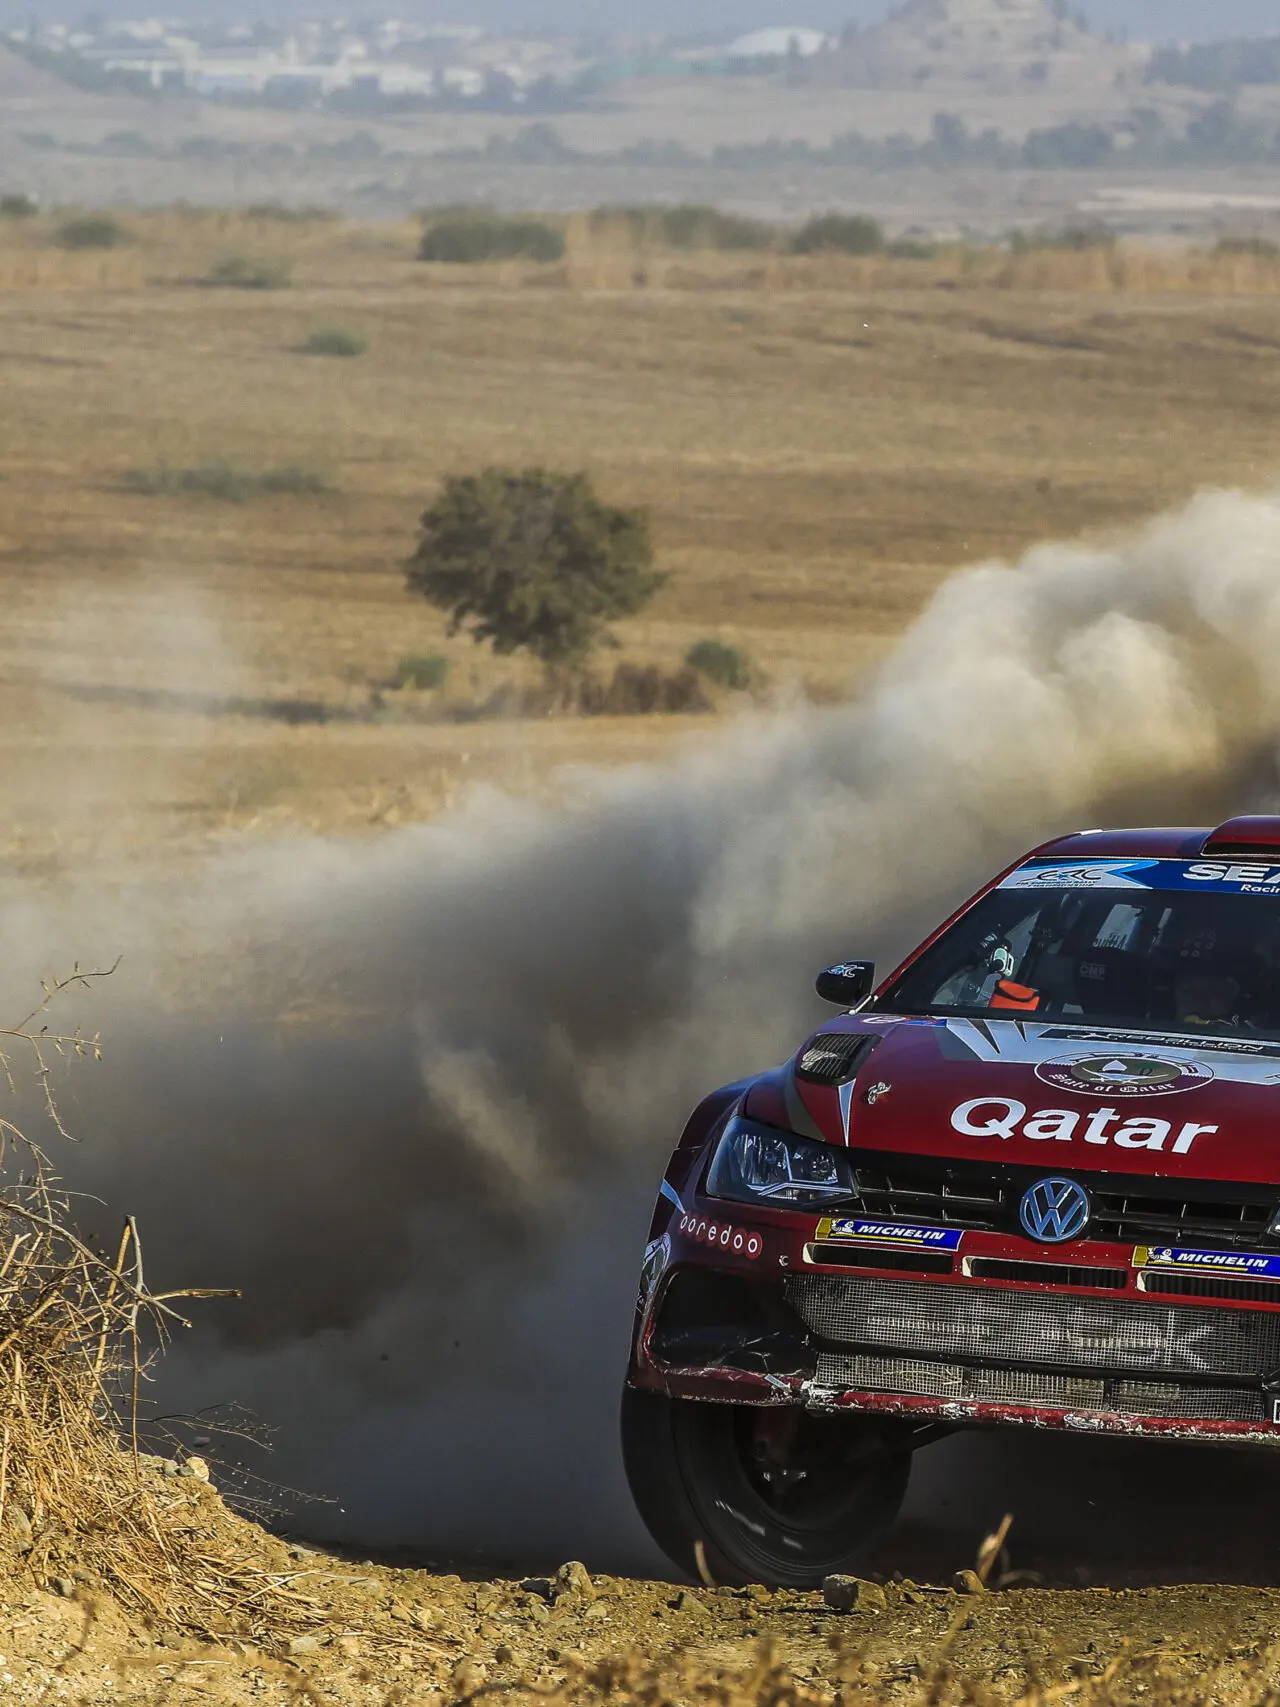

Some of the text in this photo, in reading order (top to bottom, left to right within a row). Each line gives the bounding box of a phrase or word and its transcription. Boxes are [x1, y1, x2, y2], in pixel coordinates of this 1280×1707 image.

[1049, 1073, 1176, 1093] State of Qatar
[950, 1097, 1219, 1155] Qatar
[680, 1216, 758, 1254] ooredoo
[857, 1225, 946, 1240] MICHELIN
[1177, 1253, 1269, 1267] MICHELIN
